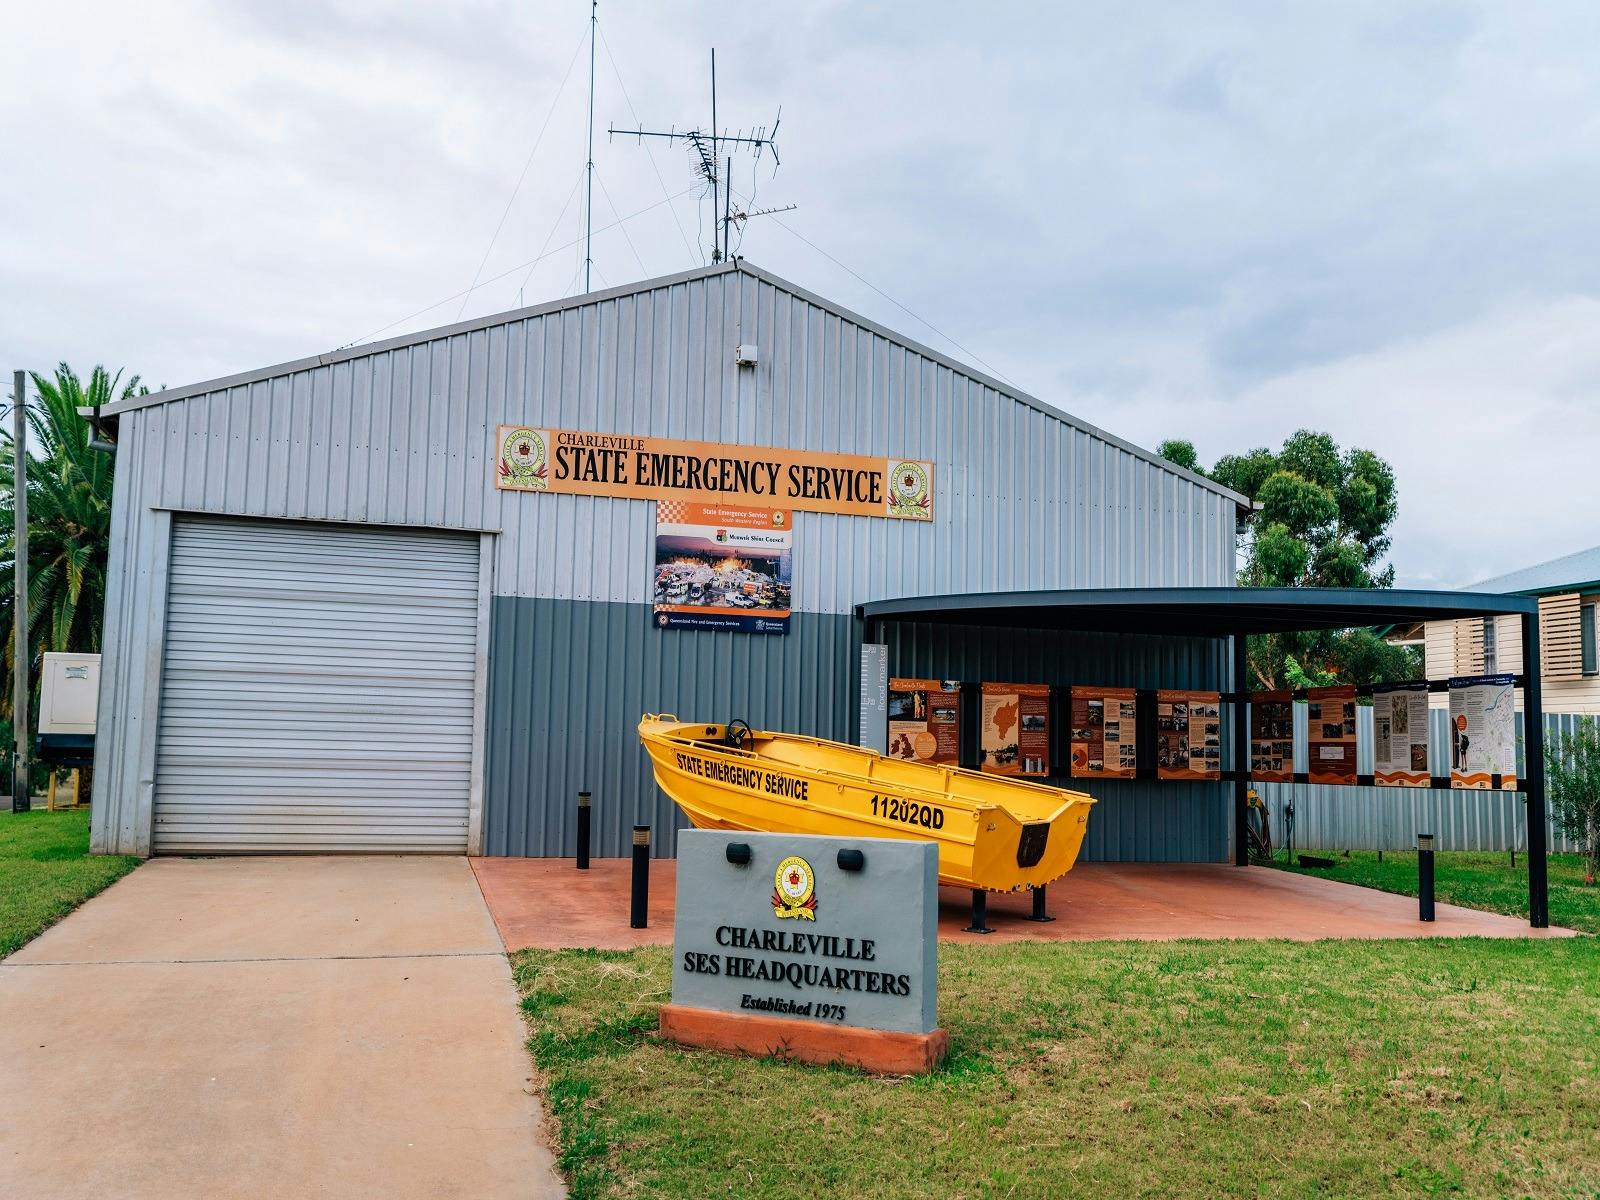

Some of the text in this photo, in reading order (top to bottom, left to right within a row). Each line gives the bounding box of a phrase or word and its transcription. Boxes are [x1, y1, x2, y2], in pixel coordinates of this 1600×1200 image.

[557, 432, 645, 451] CHARLEVILLE
[555, 446, 628, 484] STATE
[635, 452, 782, 496] EMERGENCY
[788, 464, 883, 504] SERVICE
[702, 507, 768, 519] State Emergency Service
[765, 536, 785, 544] Council
[877, 646, 886, 711] flood marker
[676, 752, 808, 800] STATE EMERGENCY SERVICE
[870, 794, 945, 830] 11202QD
[715, 925, 875, 961] CHARLEVILLE
[684, 951, 911, 997] SES HEADQUARTERS
[740, 994, 846, 1021] Established 1975
